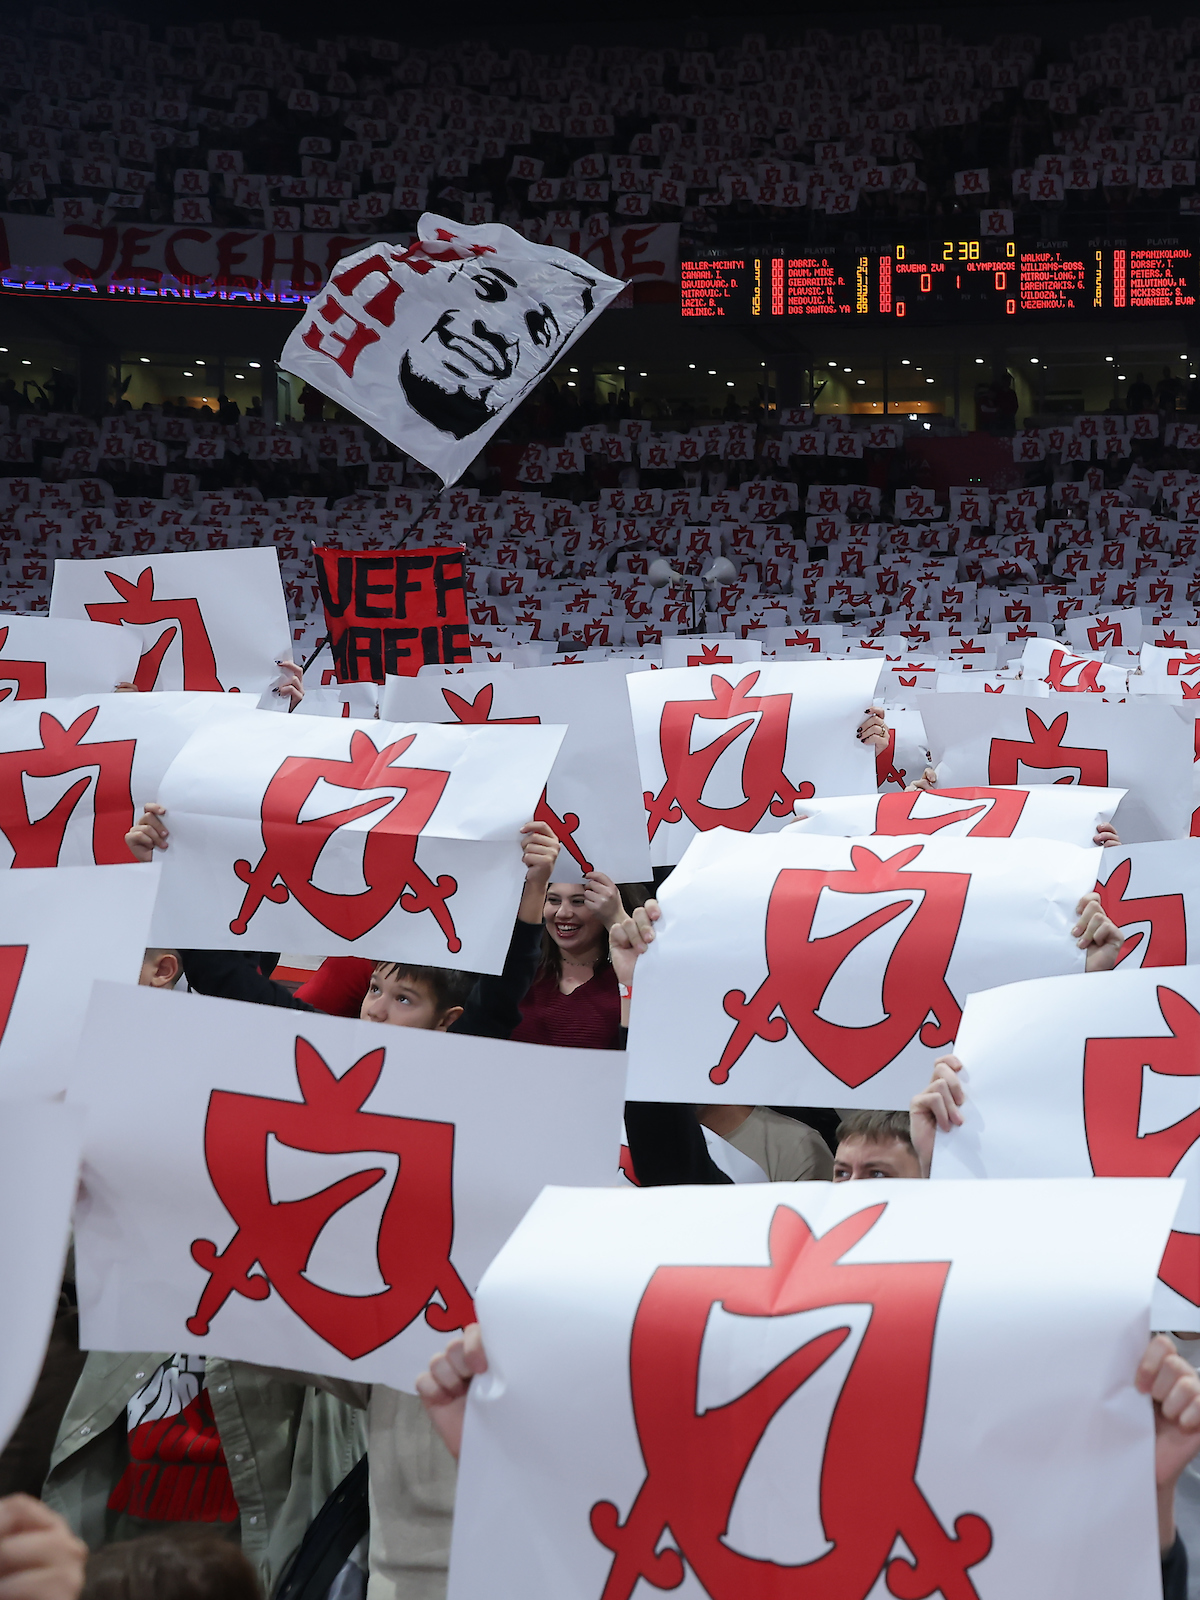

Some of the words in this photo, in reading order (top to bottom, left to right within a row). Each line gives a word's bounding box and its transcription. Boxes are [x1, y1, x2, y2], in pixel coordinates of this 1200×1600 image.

[896, 245, 905, 260] 0
[1006, 242, 1015, 257] 0
[1021, 253, 1053, 262] WALKUP,
[788, 259, 820, 268] DOBRIC,
[1130, 260, 1165, 269] DORSEY,
[814, 268, 834, 276] MIKE
[895, 264, 927, 273] CRVENA
[1130, 270, 1163, 278] PETERS,
[920, 273, 931, 292] 0
[995, 271, 1006, 290] 0
[1020, 281, 1075, 290] LARENTZAKIS,
[681, 289, 722, 298] MITROVIC,
[1020, 291, 1057, 300] VILDOZA,
[1130, 288, 1173, 297] MCKISSIC,
[681, 298, 707, 307] LAZIC,
[788, 296, 825, 305] NEDOVIC,
[1020, 300, 1065, 309] VEZENKOV,
[1130, 298, 1173, 306] FOURNIER,
[788, 306, 803, 314] DOS
[806, 305, 837, 314] SANTOS,
[839, 305, 850, 313] YA
[896, 302, 905, 317] 0
[1006, 299, 1016, 314] 0
